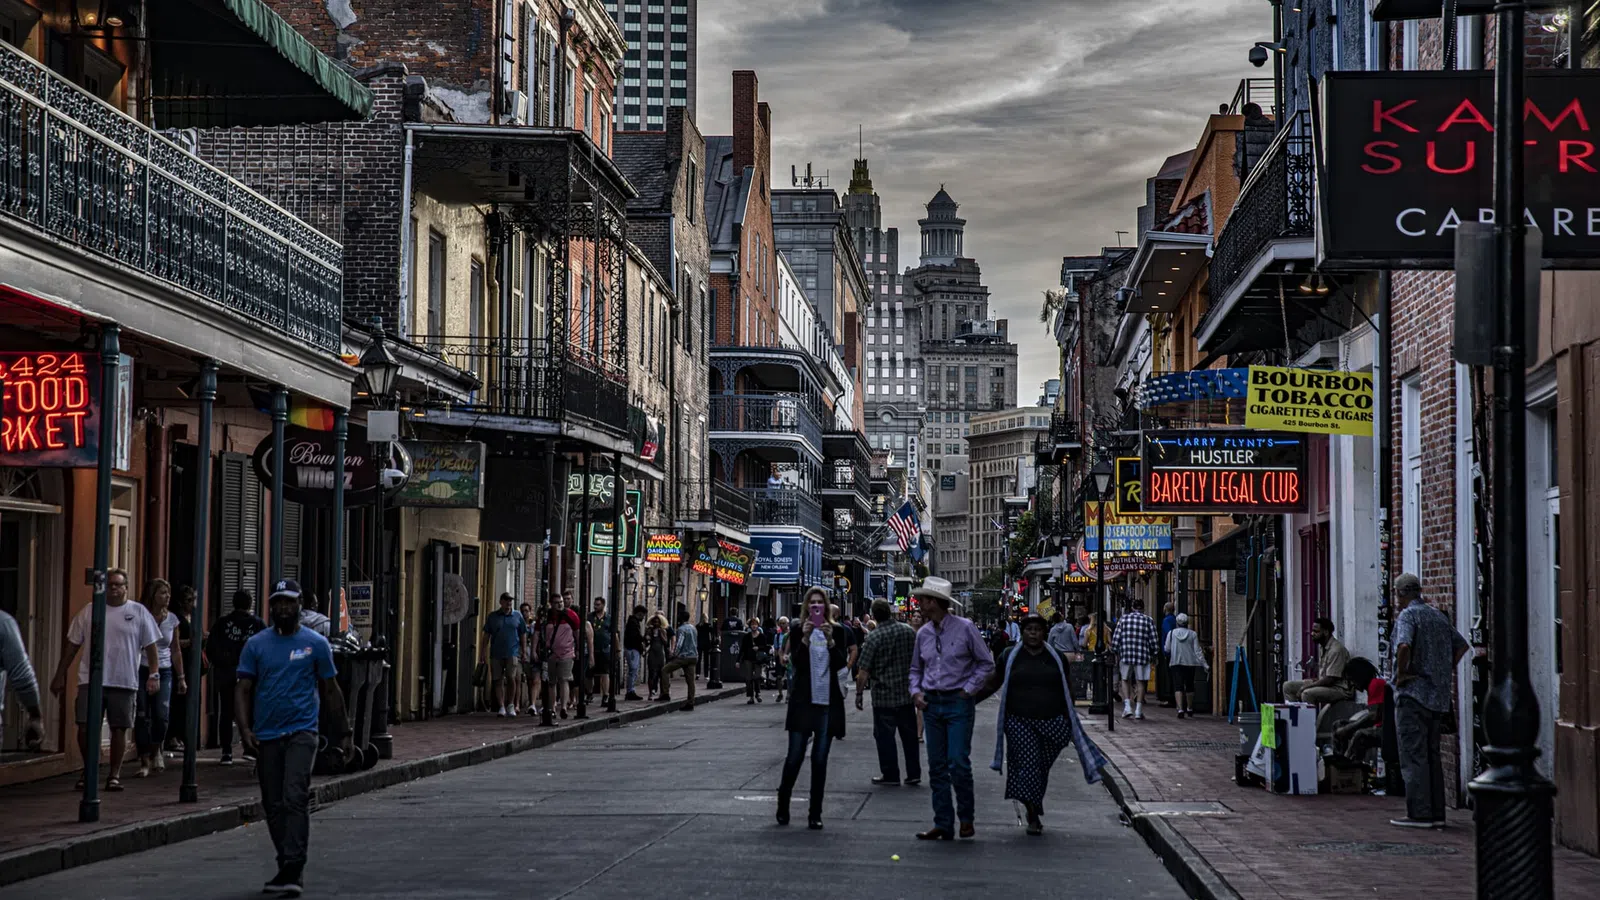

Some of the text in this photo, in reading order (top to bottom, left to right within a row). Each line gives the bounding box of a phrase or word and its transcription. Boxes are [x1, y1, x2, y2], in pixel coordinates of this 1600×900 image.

[1372, 96, 1590, 133] KAM
[1360, 140, 1598, 175] SUR
[10, 353, 85, 376] 424
[1252, 370, 1373, 391] BOURBON
[1254, 387, 1373, 409] TOBACCO
[1249, 404, 1373, 422] CIGARETTES & CIGARS
[1298, 420, 1328, 428] Bourbon
[1177, 437, 1274, 448] LARRY FLYNT'S
[289, 440, 365, 467] Bouron
[1190, 449, 1254, 464] HUSTLER
[1151, 470, 1299, 504] BARELY LEGAL CLUB
[1085, 526, 1111, 538] GUO
[1112, 525, 1145, 537] SEAFOOD
[646, 539, 682, 549] MANGO
[1103, 538, 1126, 550] YSTERS
[699, 552, 743, 572] DAUIRIS
[1090, 551, 1114, 559] CHKEN
[1110, 563, 1138, 571] ORLEANS
[1139, 563, 1162, 571] CUISINE
